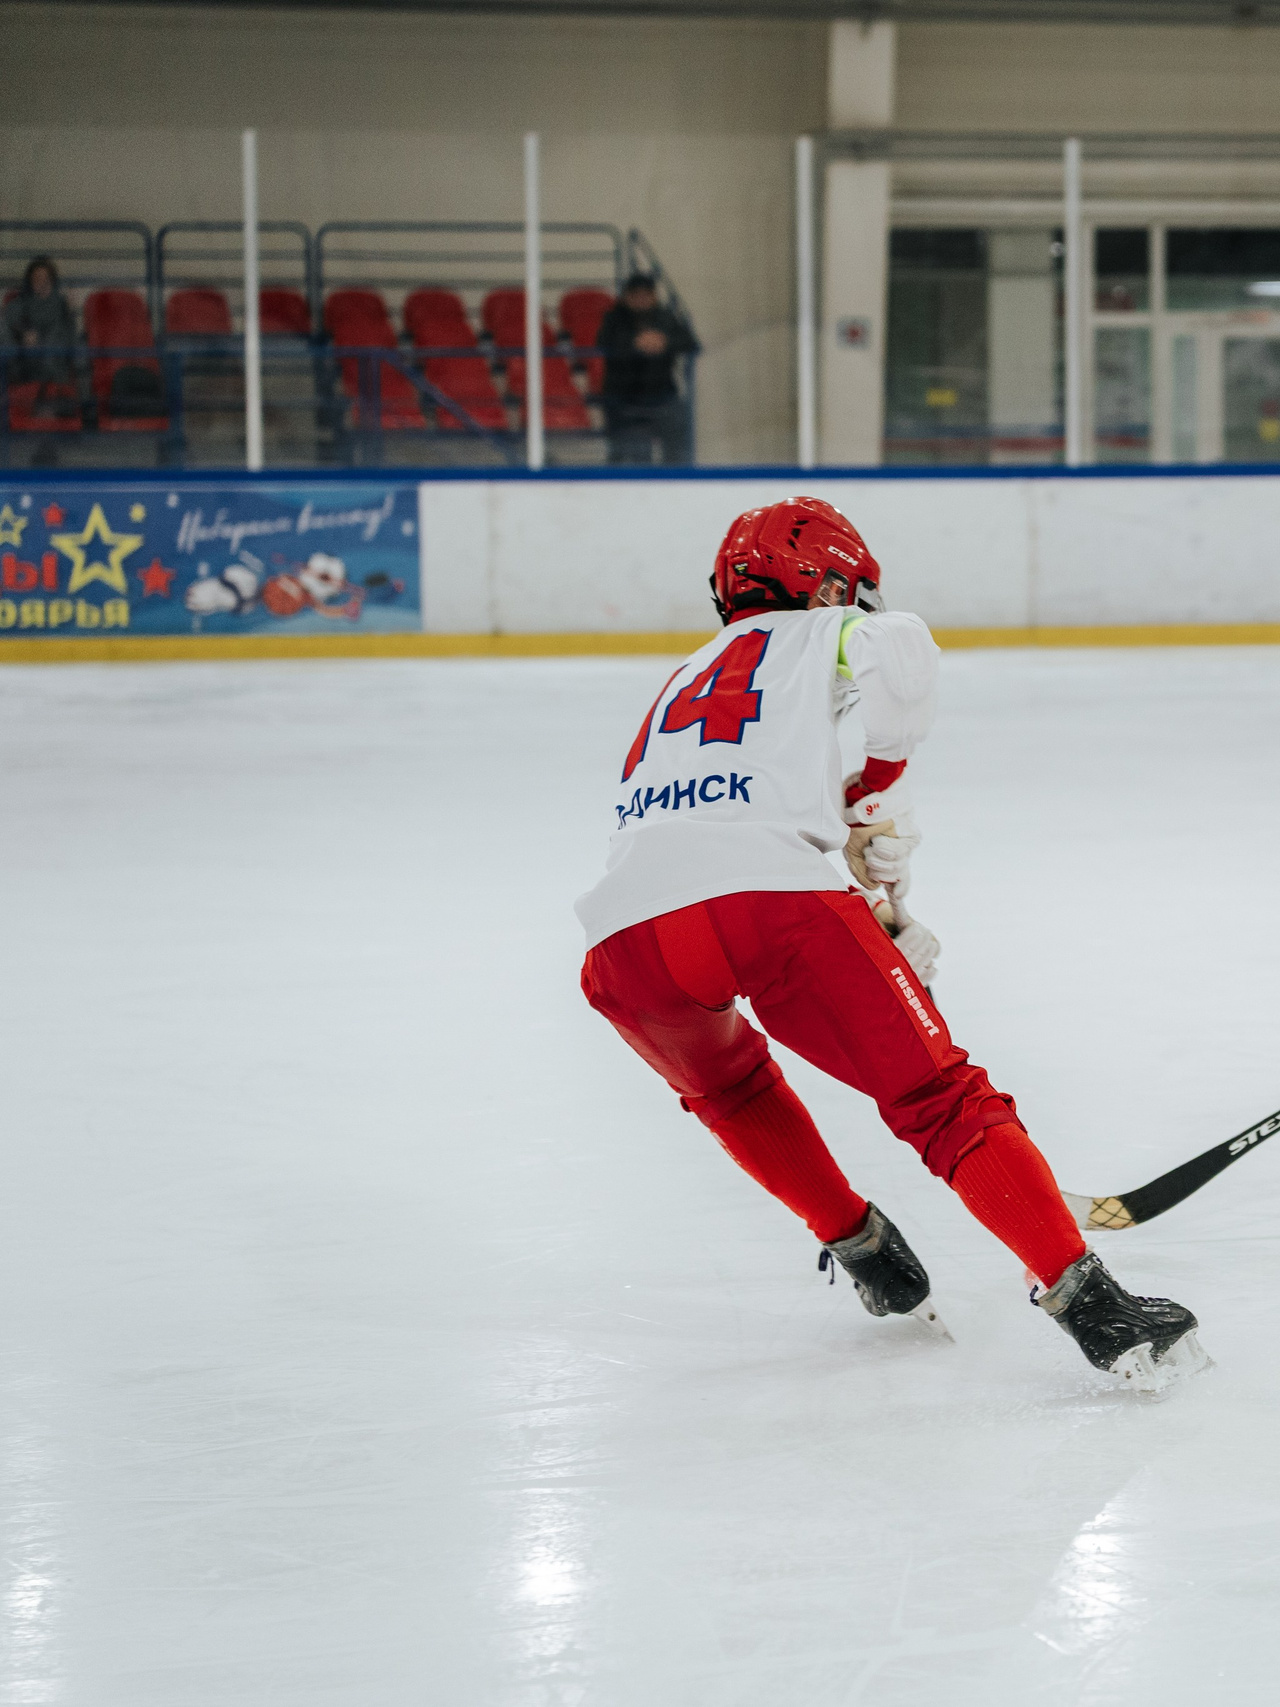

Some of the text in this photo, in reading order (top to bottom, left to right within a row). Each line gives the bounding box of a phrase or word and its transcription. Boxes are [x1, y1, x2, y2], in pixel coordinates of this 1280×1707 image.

[0, 550, 58, 594] Ы
[827, 545, 859, 567] CCM
[615, 773, 753, 830] ДИНСК
[890, 966, 940, 1038] rusport
